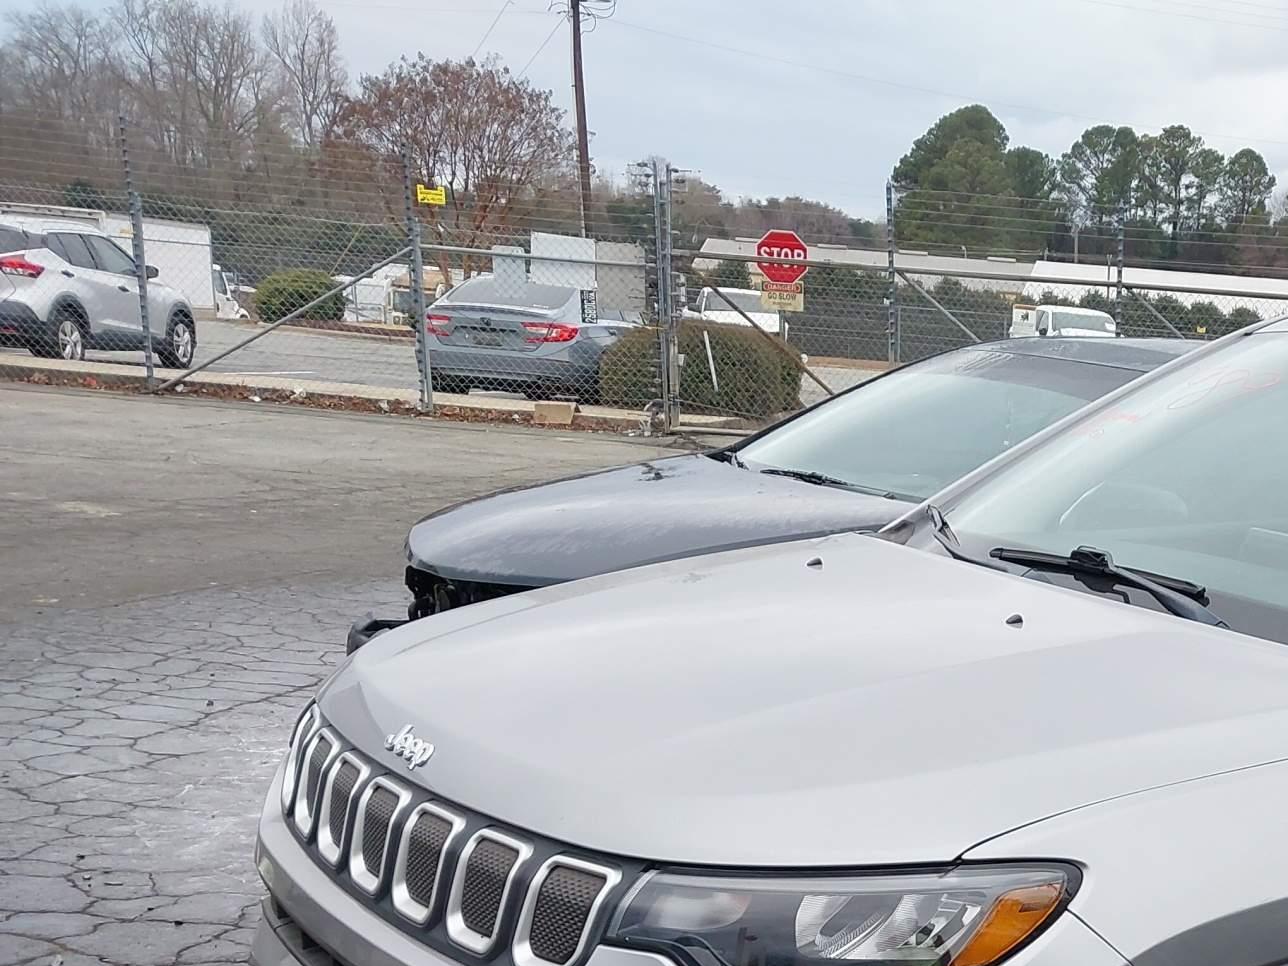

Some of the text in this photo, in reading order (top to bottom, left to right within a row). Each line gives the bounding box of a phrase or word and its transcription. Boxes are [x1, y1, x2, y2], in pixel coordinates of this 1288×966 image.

[760, 246, 805, 269] STOP
[767, 283, 797, 291] DANGER
[767, 292, 797, 301] GO SLOW
[384, 724, 436, 771] Jeep
